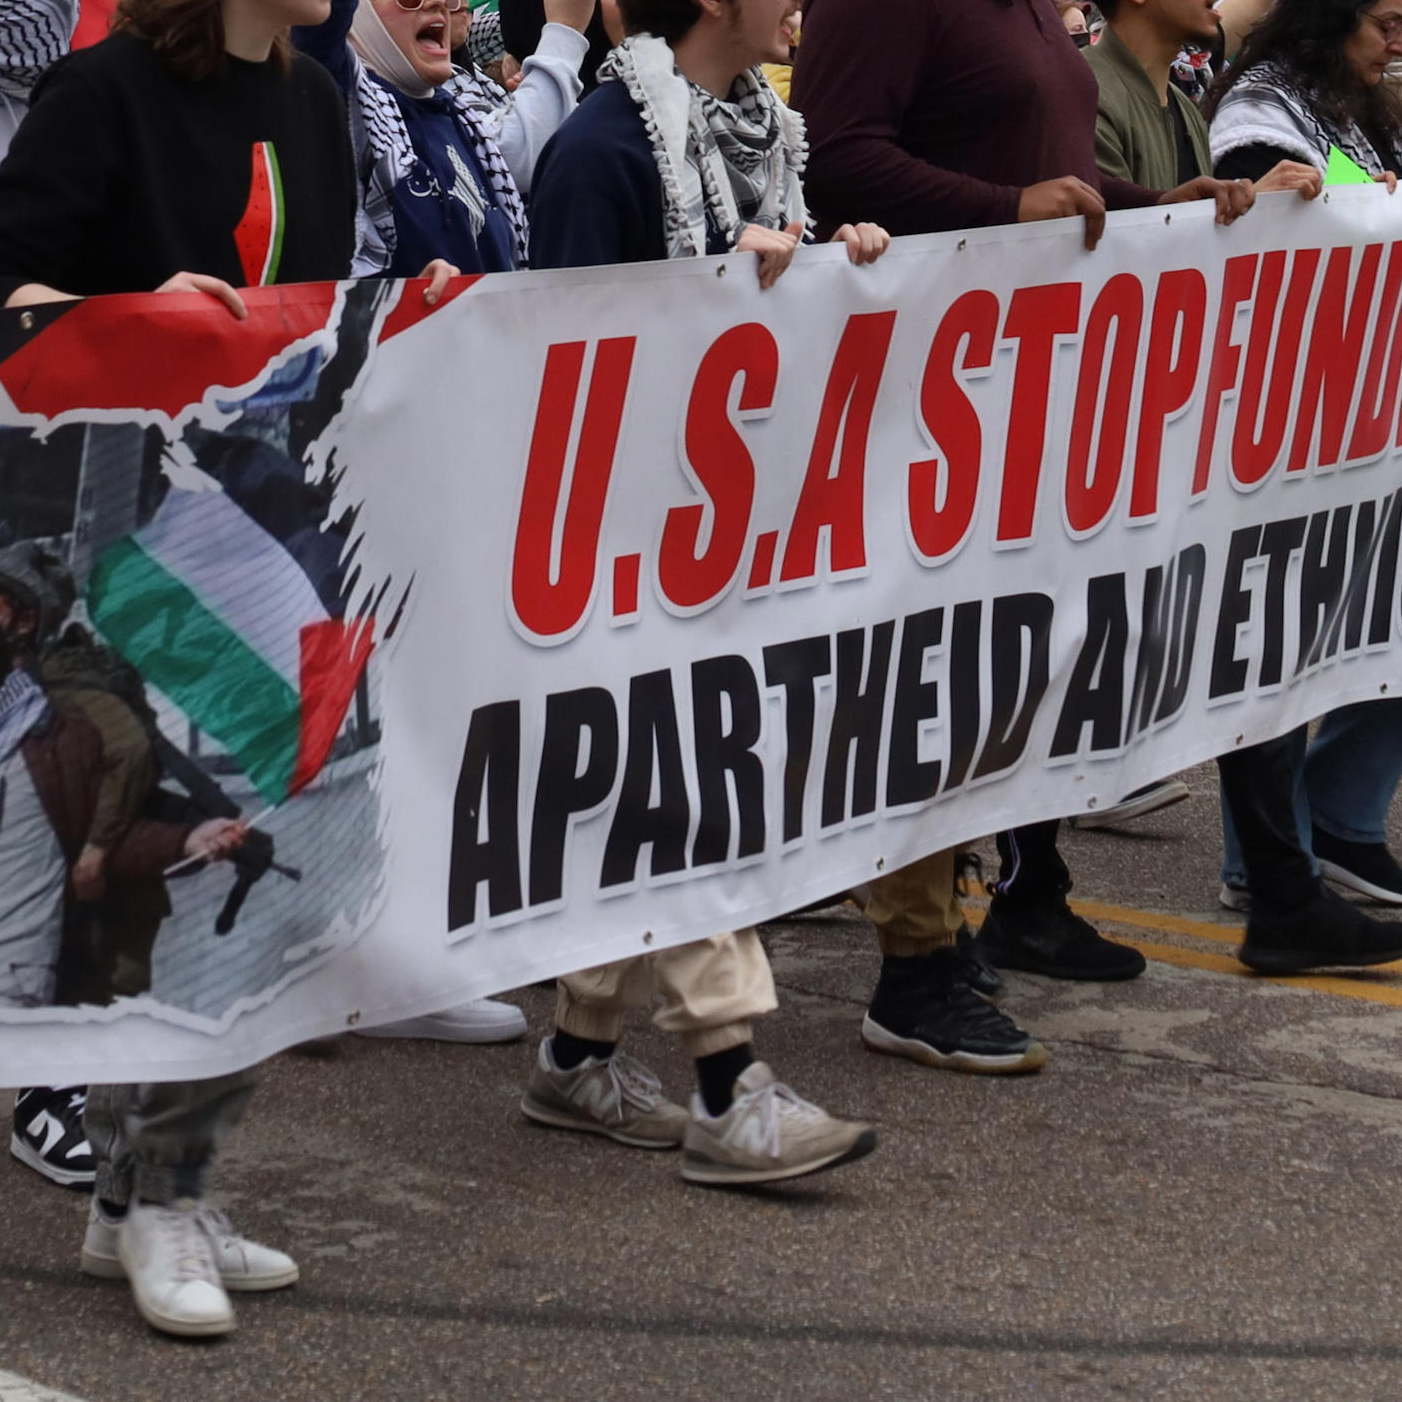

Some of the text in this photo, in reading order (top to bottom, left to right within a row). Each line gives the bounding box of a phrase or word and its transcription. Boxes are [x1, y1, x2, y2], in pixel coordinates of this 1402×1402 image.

[510, 309, 898, 637] U.S.A
[907, 269, 1207, 558] STOP
[446, 591, 1055, 934] APARTHEID
[1047, 542, 1207, 759] AND
